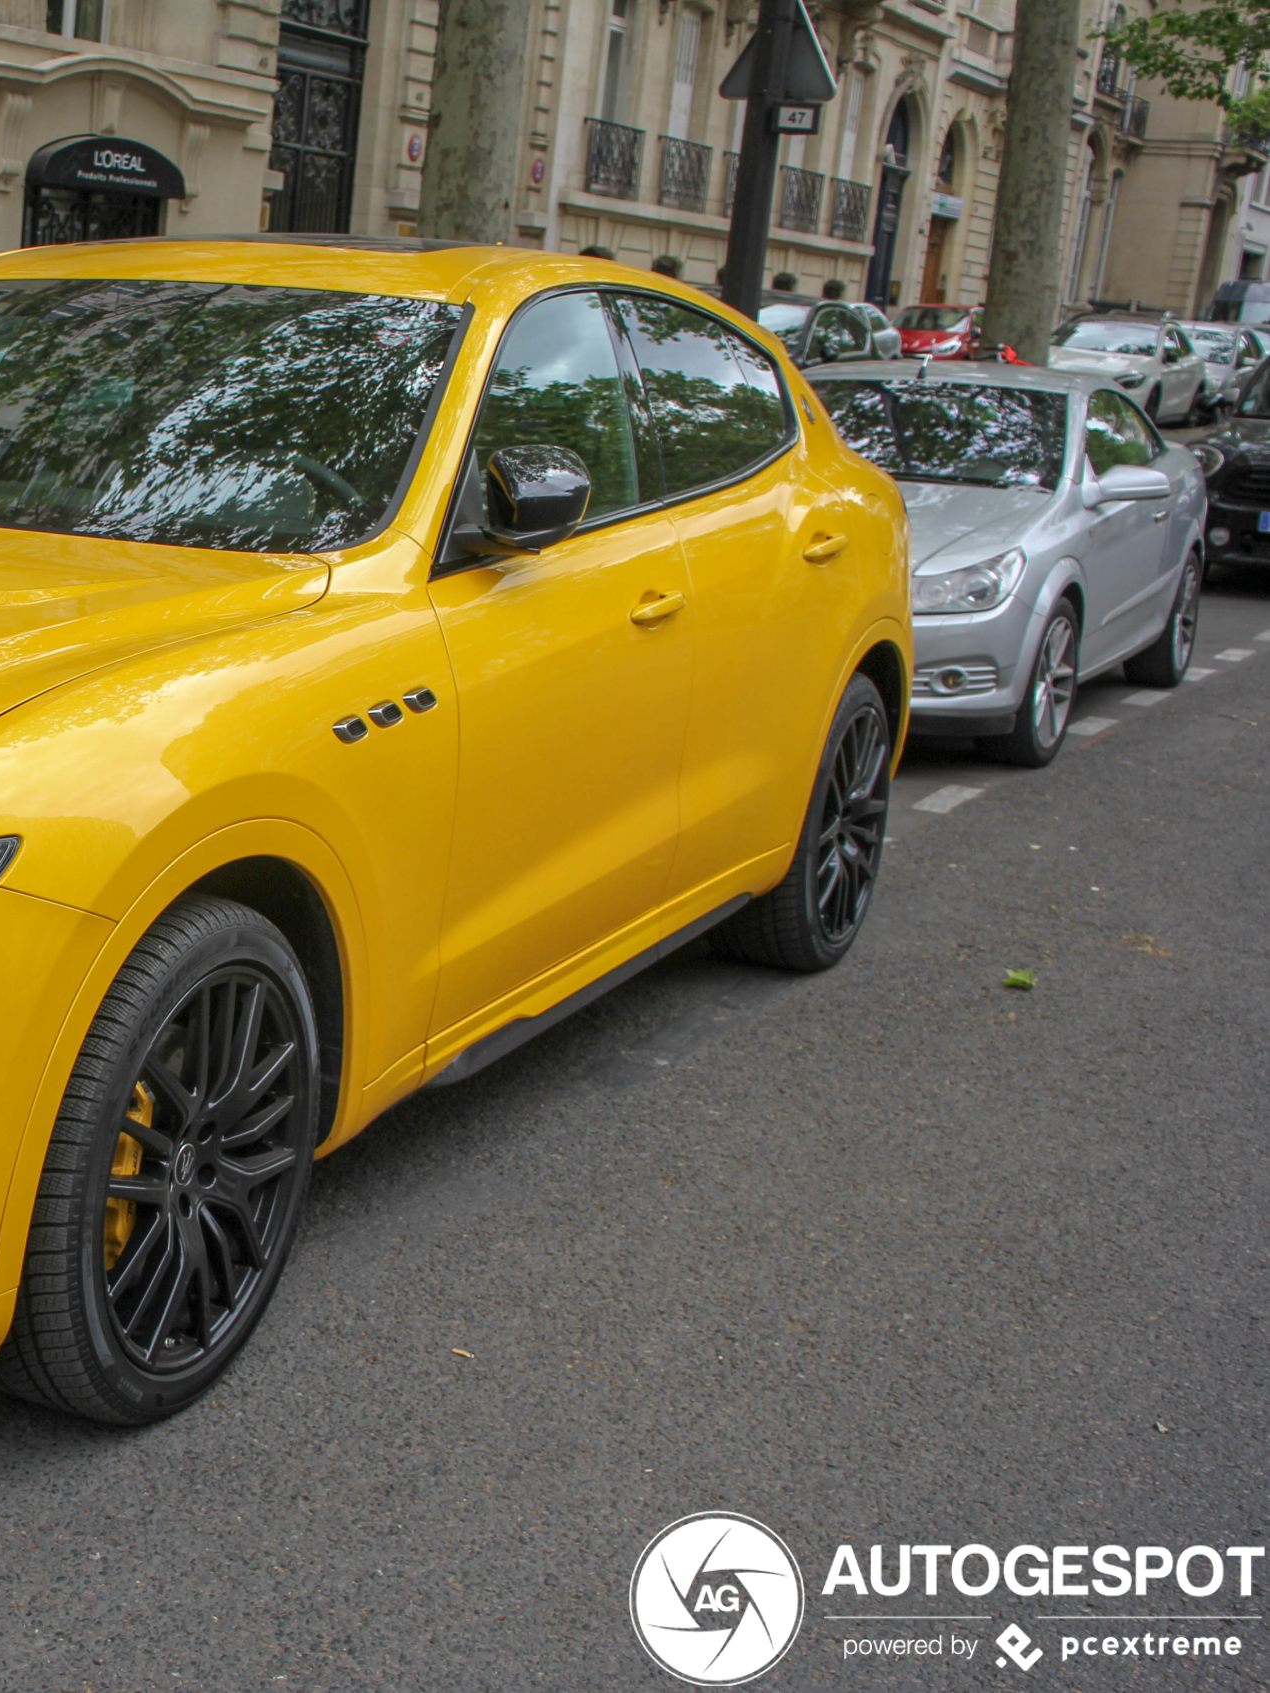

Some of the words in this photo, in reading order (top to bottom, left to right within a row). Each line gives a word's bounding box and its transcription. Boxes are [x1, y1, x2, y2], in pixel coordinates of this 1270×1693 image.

[788, 111, 806, 124] 47
[93, 149, 146, 172] L'ORÉAL
[77, 170, 107, 181] Produits
[109, 174, 157, 188] Professionnels
